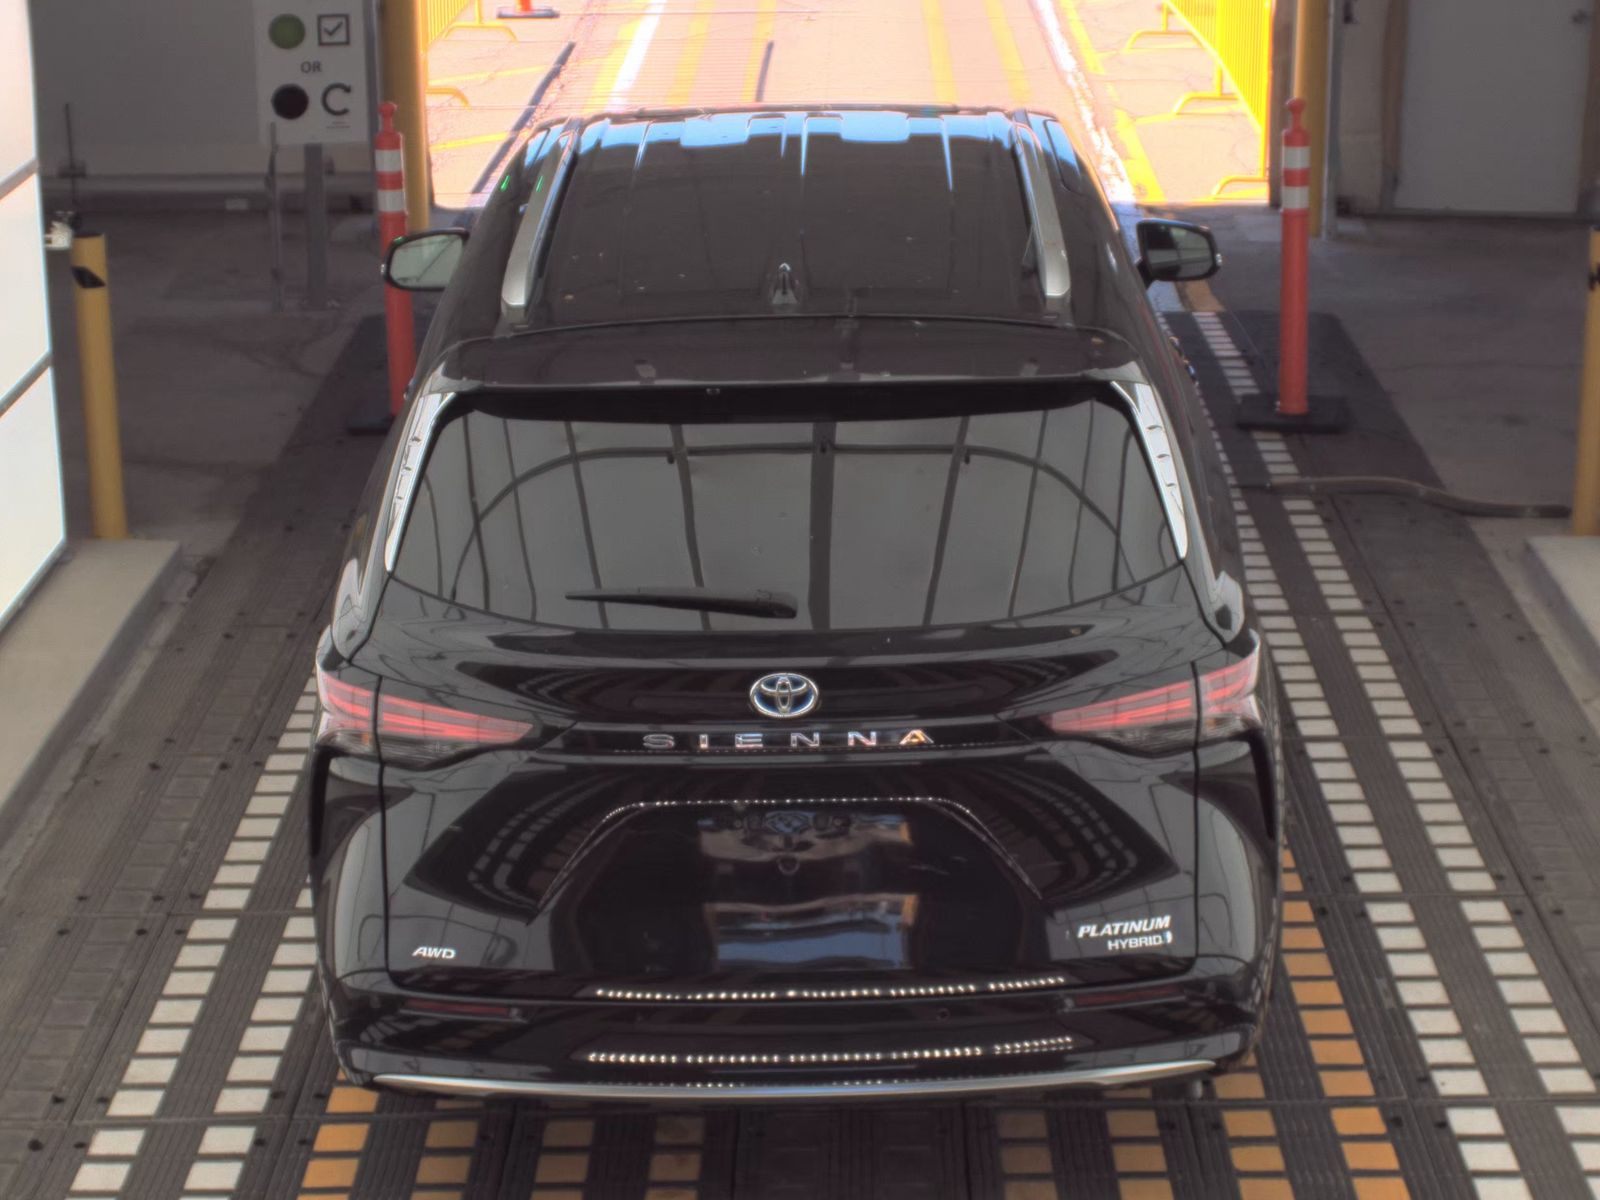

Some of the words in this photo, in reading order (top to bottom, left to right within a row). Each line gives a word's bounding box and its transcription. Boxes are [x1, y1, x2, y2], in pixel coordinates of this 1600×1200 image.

[301, 61, 322, 73] OR
[643, 728, 935, 749] SIENNA
[1077, 914, 1171, 938] PLATINUM
[1107, 934, 1163, 951] HYBRID
[411, 946, 456, 959] AWD
